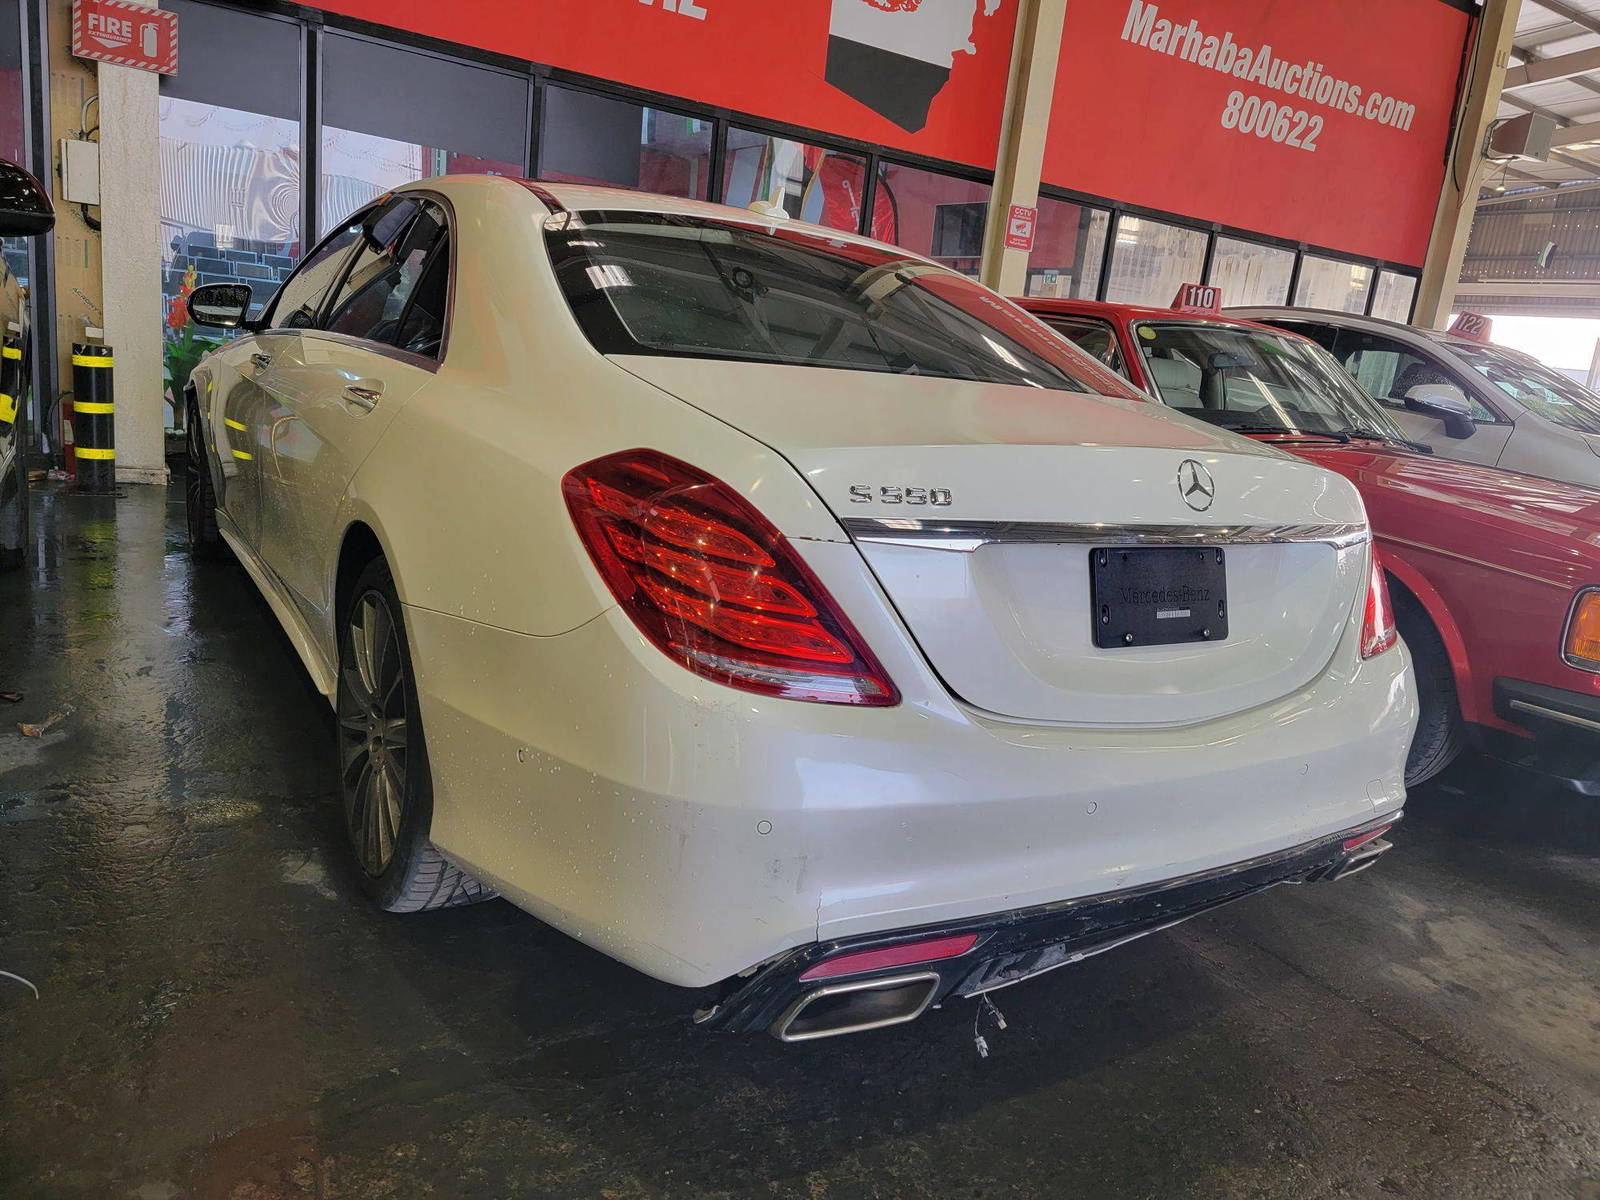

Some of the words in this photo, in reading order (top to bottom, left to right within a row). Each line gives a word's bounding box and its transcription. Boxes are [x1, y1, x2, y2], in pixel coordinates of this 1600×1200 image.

[88, 13, 132, 38] FIRE
[1120, 0, 1416, 132] MarhabaAuctions.com
[1221, 90, 1324, 152] 800622
[1014, 207, 1032, 217] CCTV
[1189, 286, 1214, 308] 110
[1458, 315, 1485, 334] 122
[849, 484, 873, 503] S
[1120, 584, 1210, 605] Mercedes-Benz
